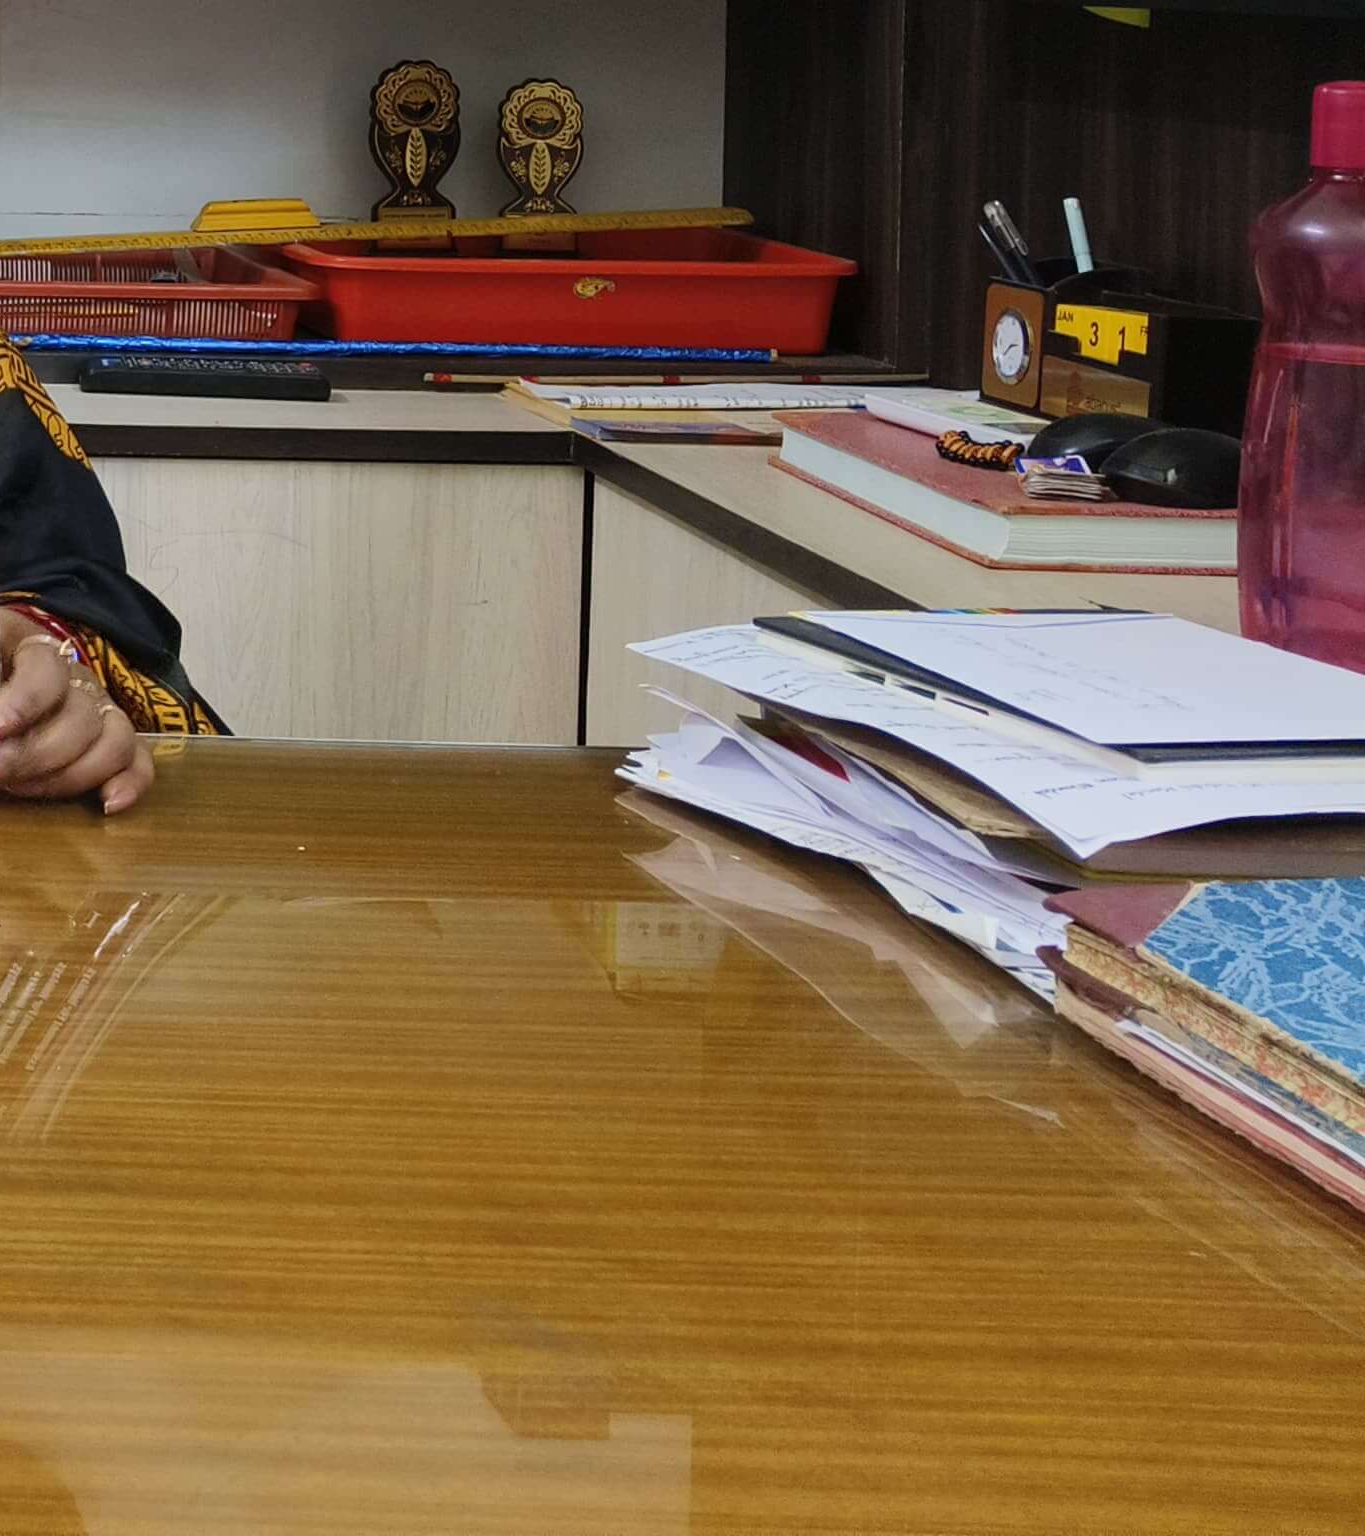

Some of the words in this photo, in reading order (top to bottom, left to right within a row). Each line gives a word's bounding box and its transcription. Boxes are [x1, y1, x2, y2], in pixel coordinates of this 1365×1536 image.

[1057, 310, 1074, 323] JAN
[1089, 321, 1099, 347] 3
[1118, 325, 1126, 351] 1
